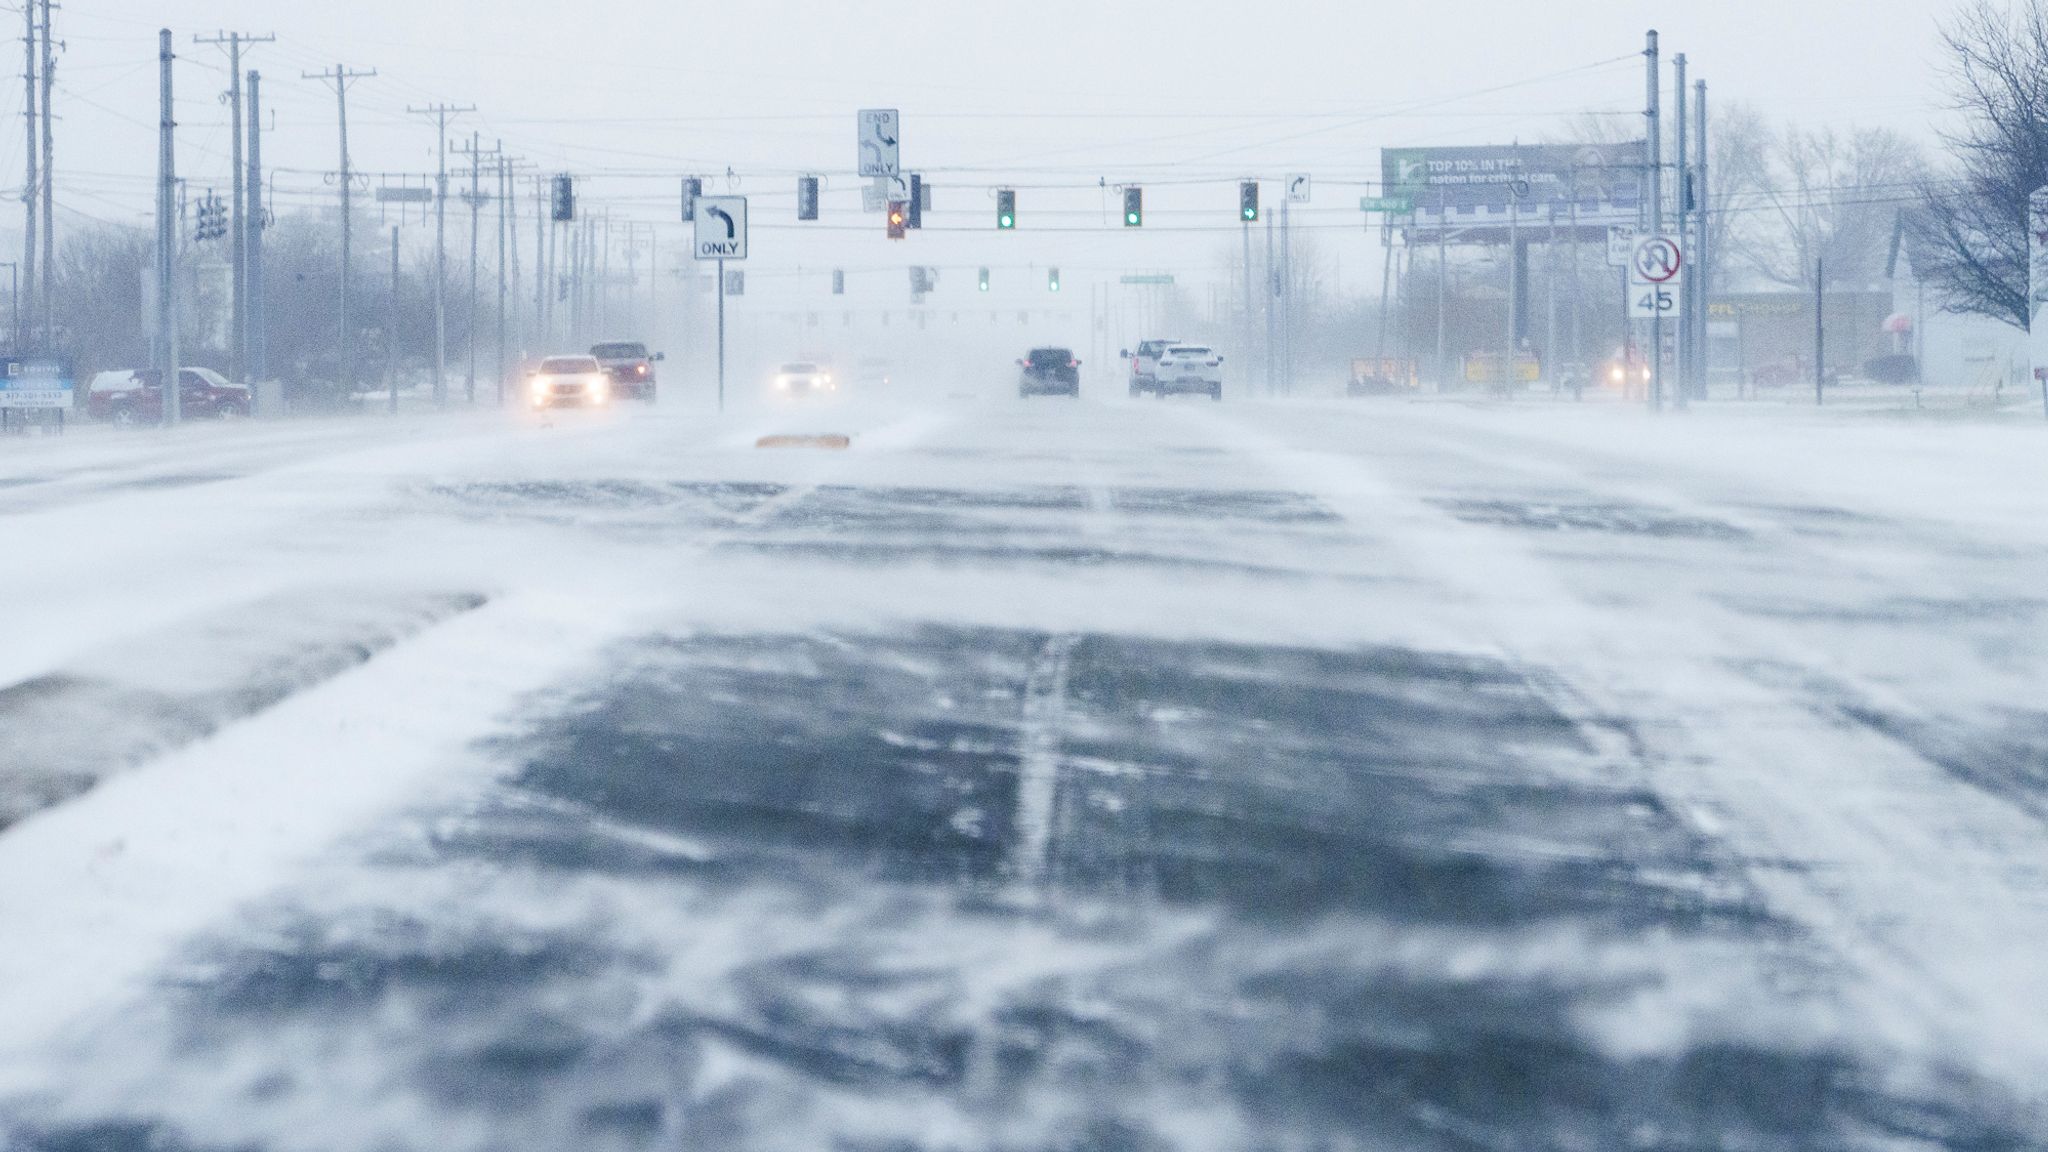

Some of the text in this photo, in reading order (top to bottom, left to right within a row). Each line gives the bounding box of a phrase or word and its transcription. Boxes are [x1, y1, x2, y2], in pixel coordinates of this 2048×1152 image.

[866, 113, 890, 124] END
[864, 163, 893, 174] ONLY
[1427, 160, 1453, 172] TOP
[1480, 159, 1495, 171] IN
[1429, 174, 1467, 184] nation
[1469, 173, 1485, 183] for
[702, 242, 739, 255] ONLY
[1637, 291, 1673, 311] 45
